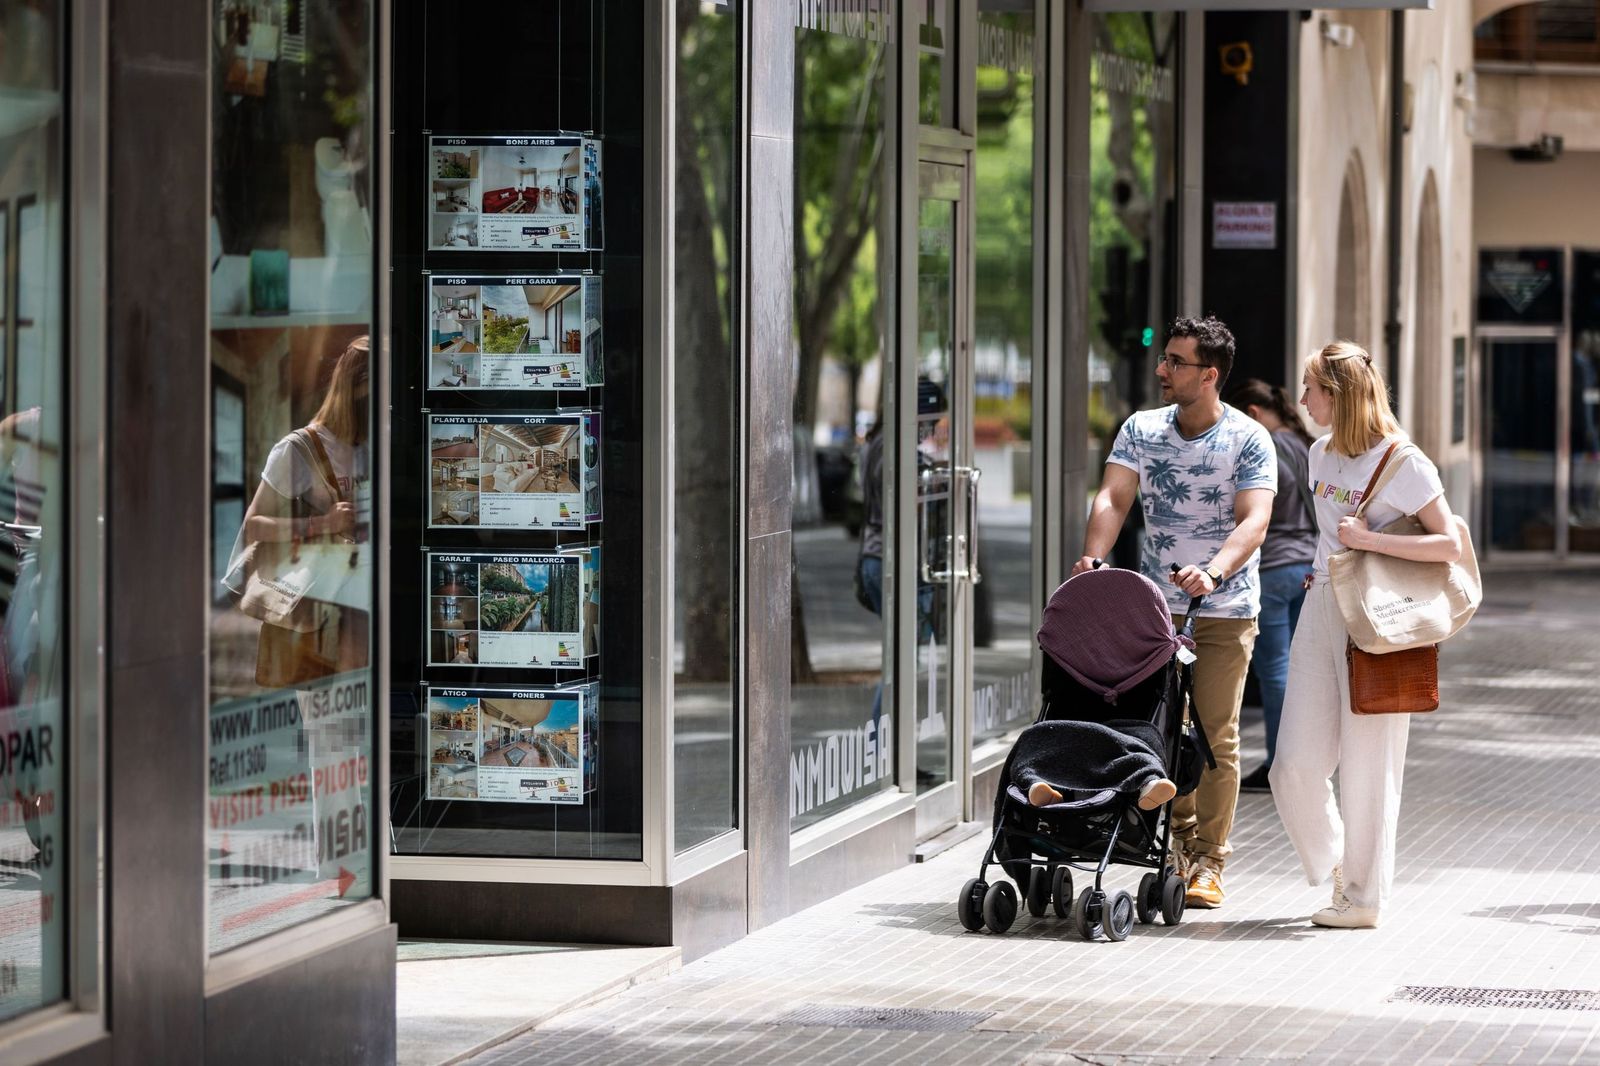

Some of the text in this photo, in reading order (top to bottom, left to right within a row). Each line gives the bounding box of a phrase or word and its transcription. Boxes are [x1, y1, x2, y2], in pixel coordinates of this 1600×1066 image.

[447, 138, 556, 146] PISO BONS AIRES
[447, 278, 557, 286] PISO PERE GARAU
[433, 416, 547, 425] PLANTA BAJA CORT
[439, 555, 566, 564] GARAJE PASEO MALLORCA
[1372, 596, 1414, 613] Shoes with
[1376, 600, 1432, 619] Mediterranean
[210, 681, 367, 746] www.inmovisa.com
[210, 755, 368, 830] VISITE PISO PILOTO
